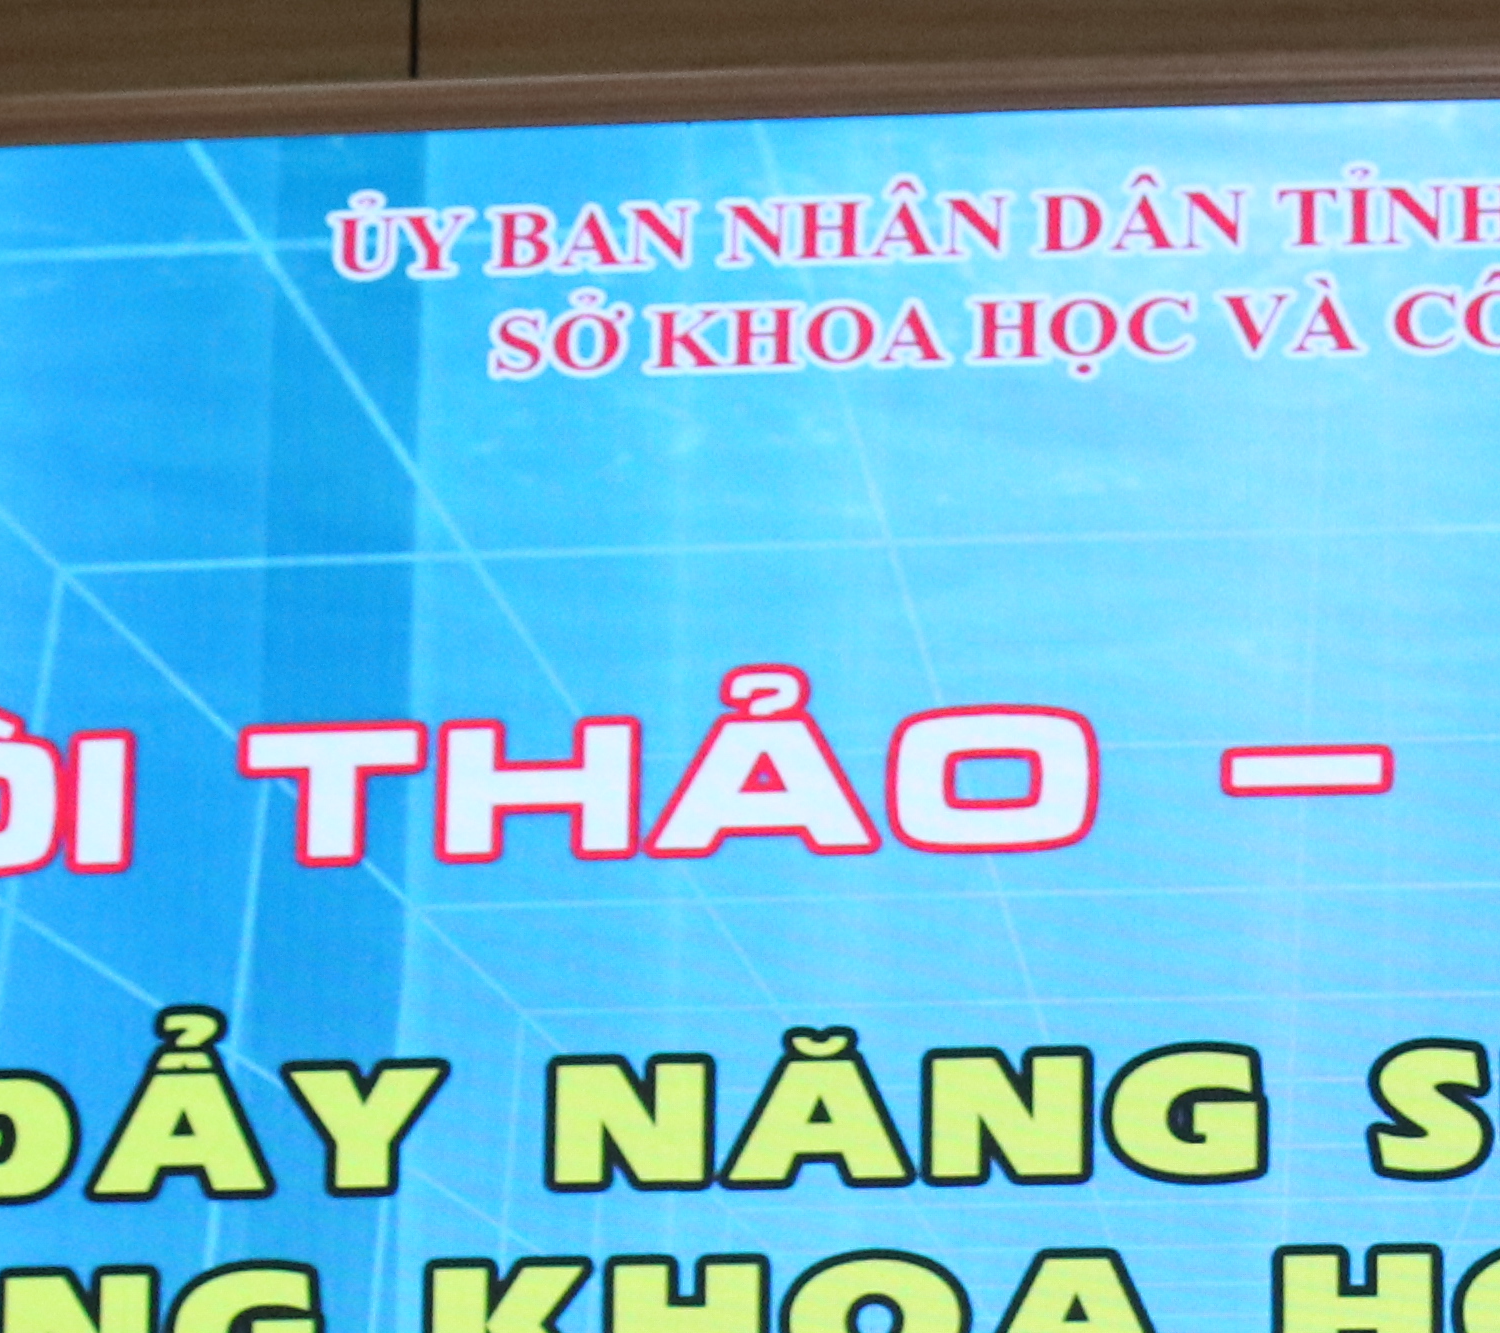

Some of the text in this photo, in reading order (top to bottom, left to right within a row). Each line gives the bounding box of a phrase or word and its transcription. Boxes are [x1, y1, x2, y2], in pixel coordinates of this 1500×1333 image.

[328, 188, 470, 283] ỦY
[489, 199, 694, 275] BAN
[717, 177, 1008, 269] NHÂN
[1030, 175, 1248, 262] DÂN
[490, 293, 628, 380] SỞ
[645, 291, 945, 375] KHOA
[967, 288, 1194, 380] HỌC
[1223, 273, 1363, 361] VÀ
[239, 666, 1102, 866] THẢO
[545, 1027, 1269, 1192] NĂNG
